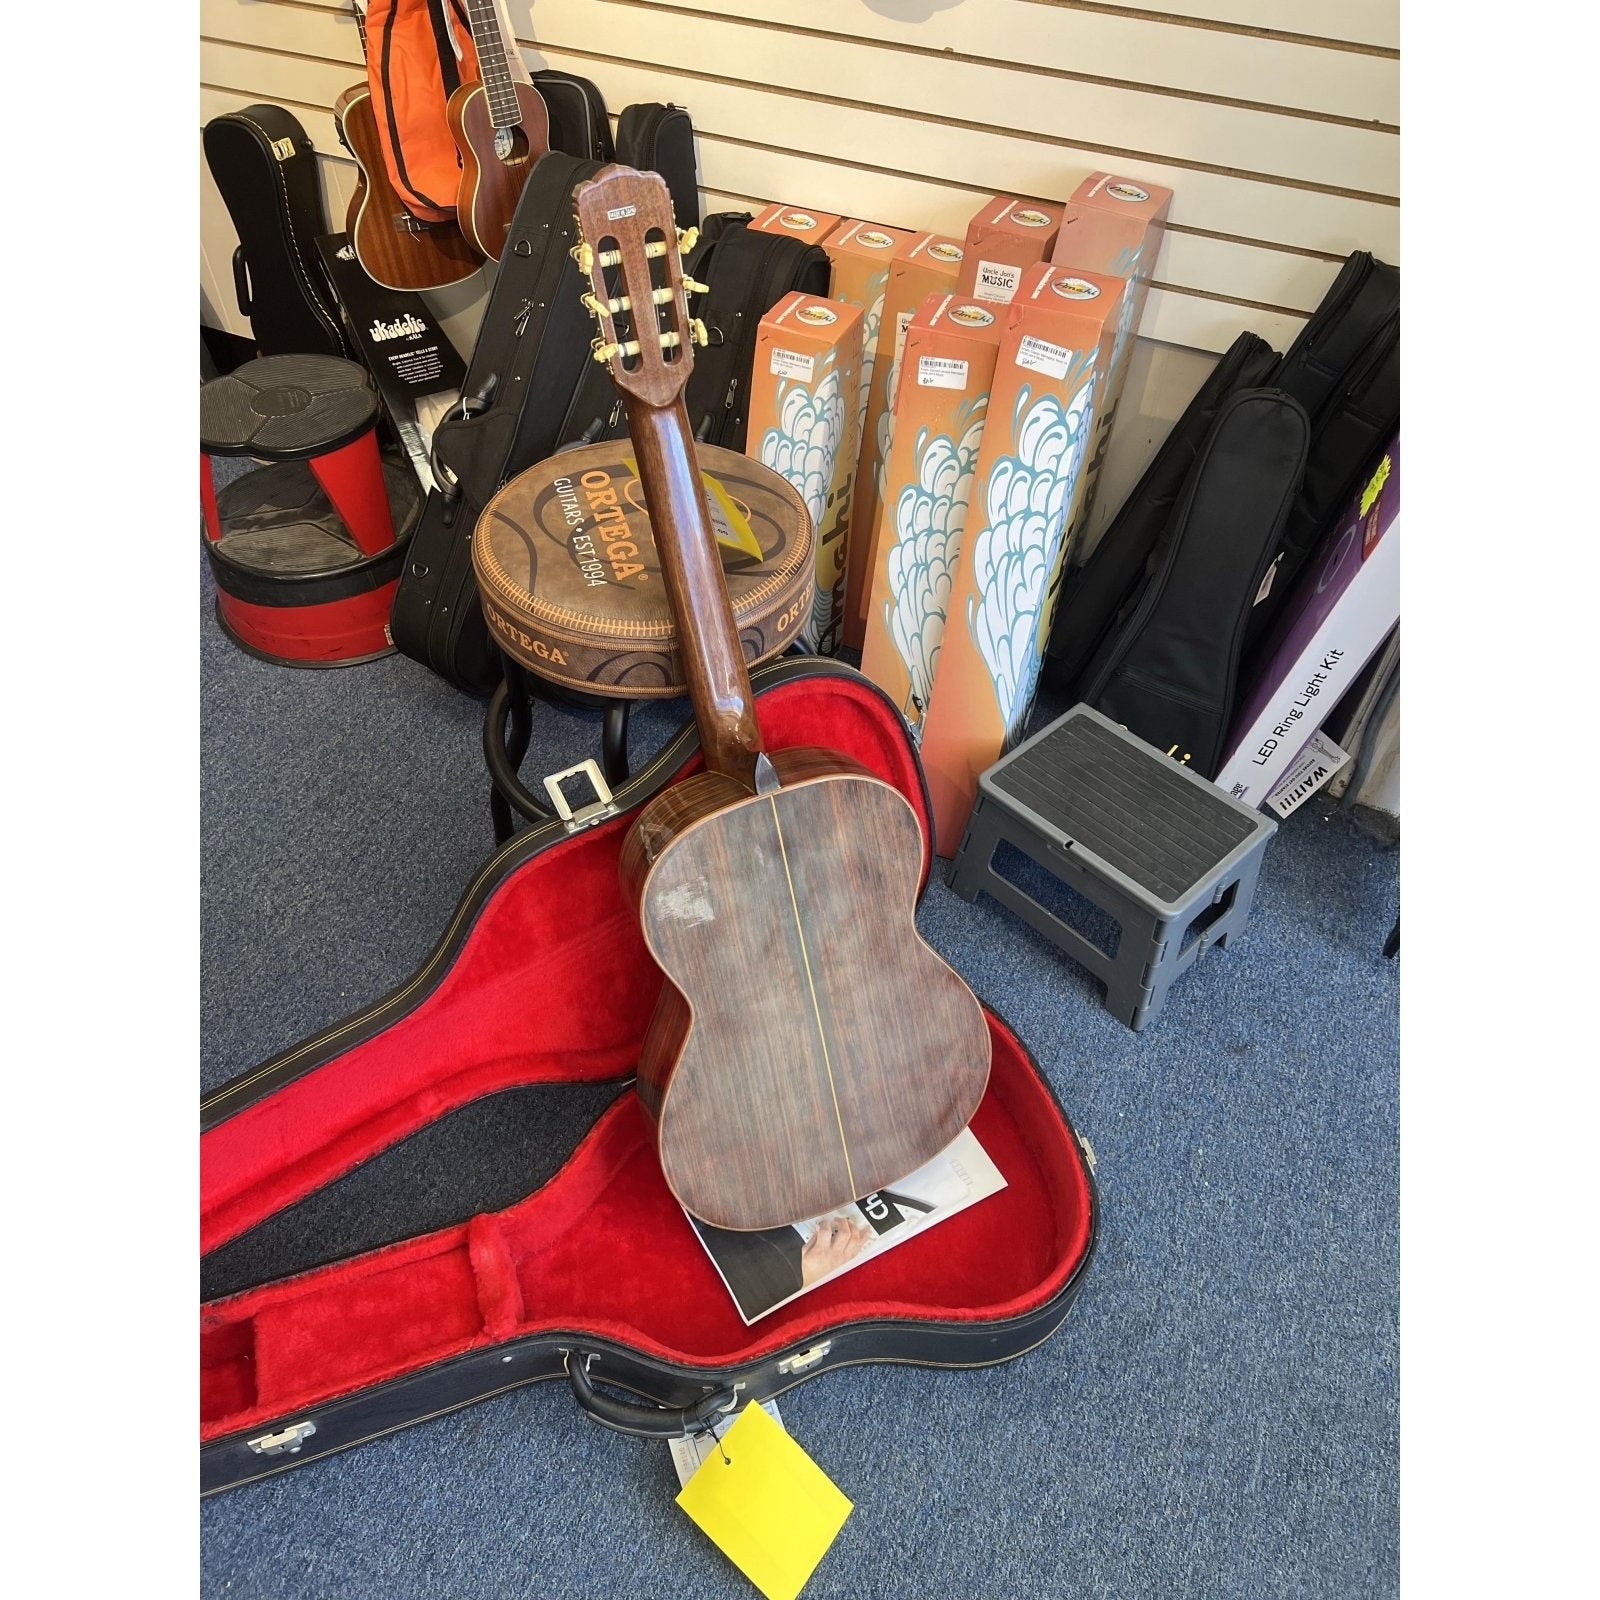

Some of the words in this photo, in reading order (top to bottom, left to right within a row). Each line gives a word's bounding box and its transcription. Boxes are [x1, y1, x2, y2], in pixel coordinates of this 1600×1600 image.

[981, 274, 1014, 289] MUSIC
[982, 267, 999, 276] Uncle
[1054, 281, 1098, 296] Amahi
[553, 477, 585, 525] GUITARS
[580, 470, 646, 581] ORTEGA
[487, 602, 567, 666] ORTEGA
[1252, 738, 1279, 766] LED
[1272, 708, 1303, 738] Ring
[1294, 672, 1328, 707] Light
[1319, 648, 1345, 672] Kit
[1279, 766, 1329, 811] WAIT!!!
